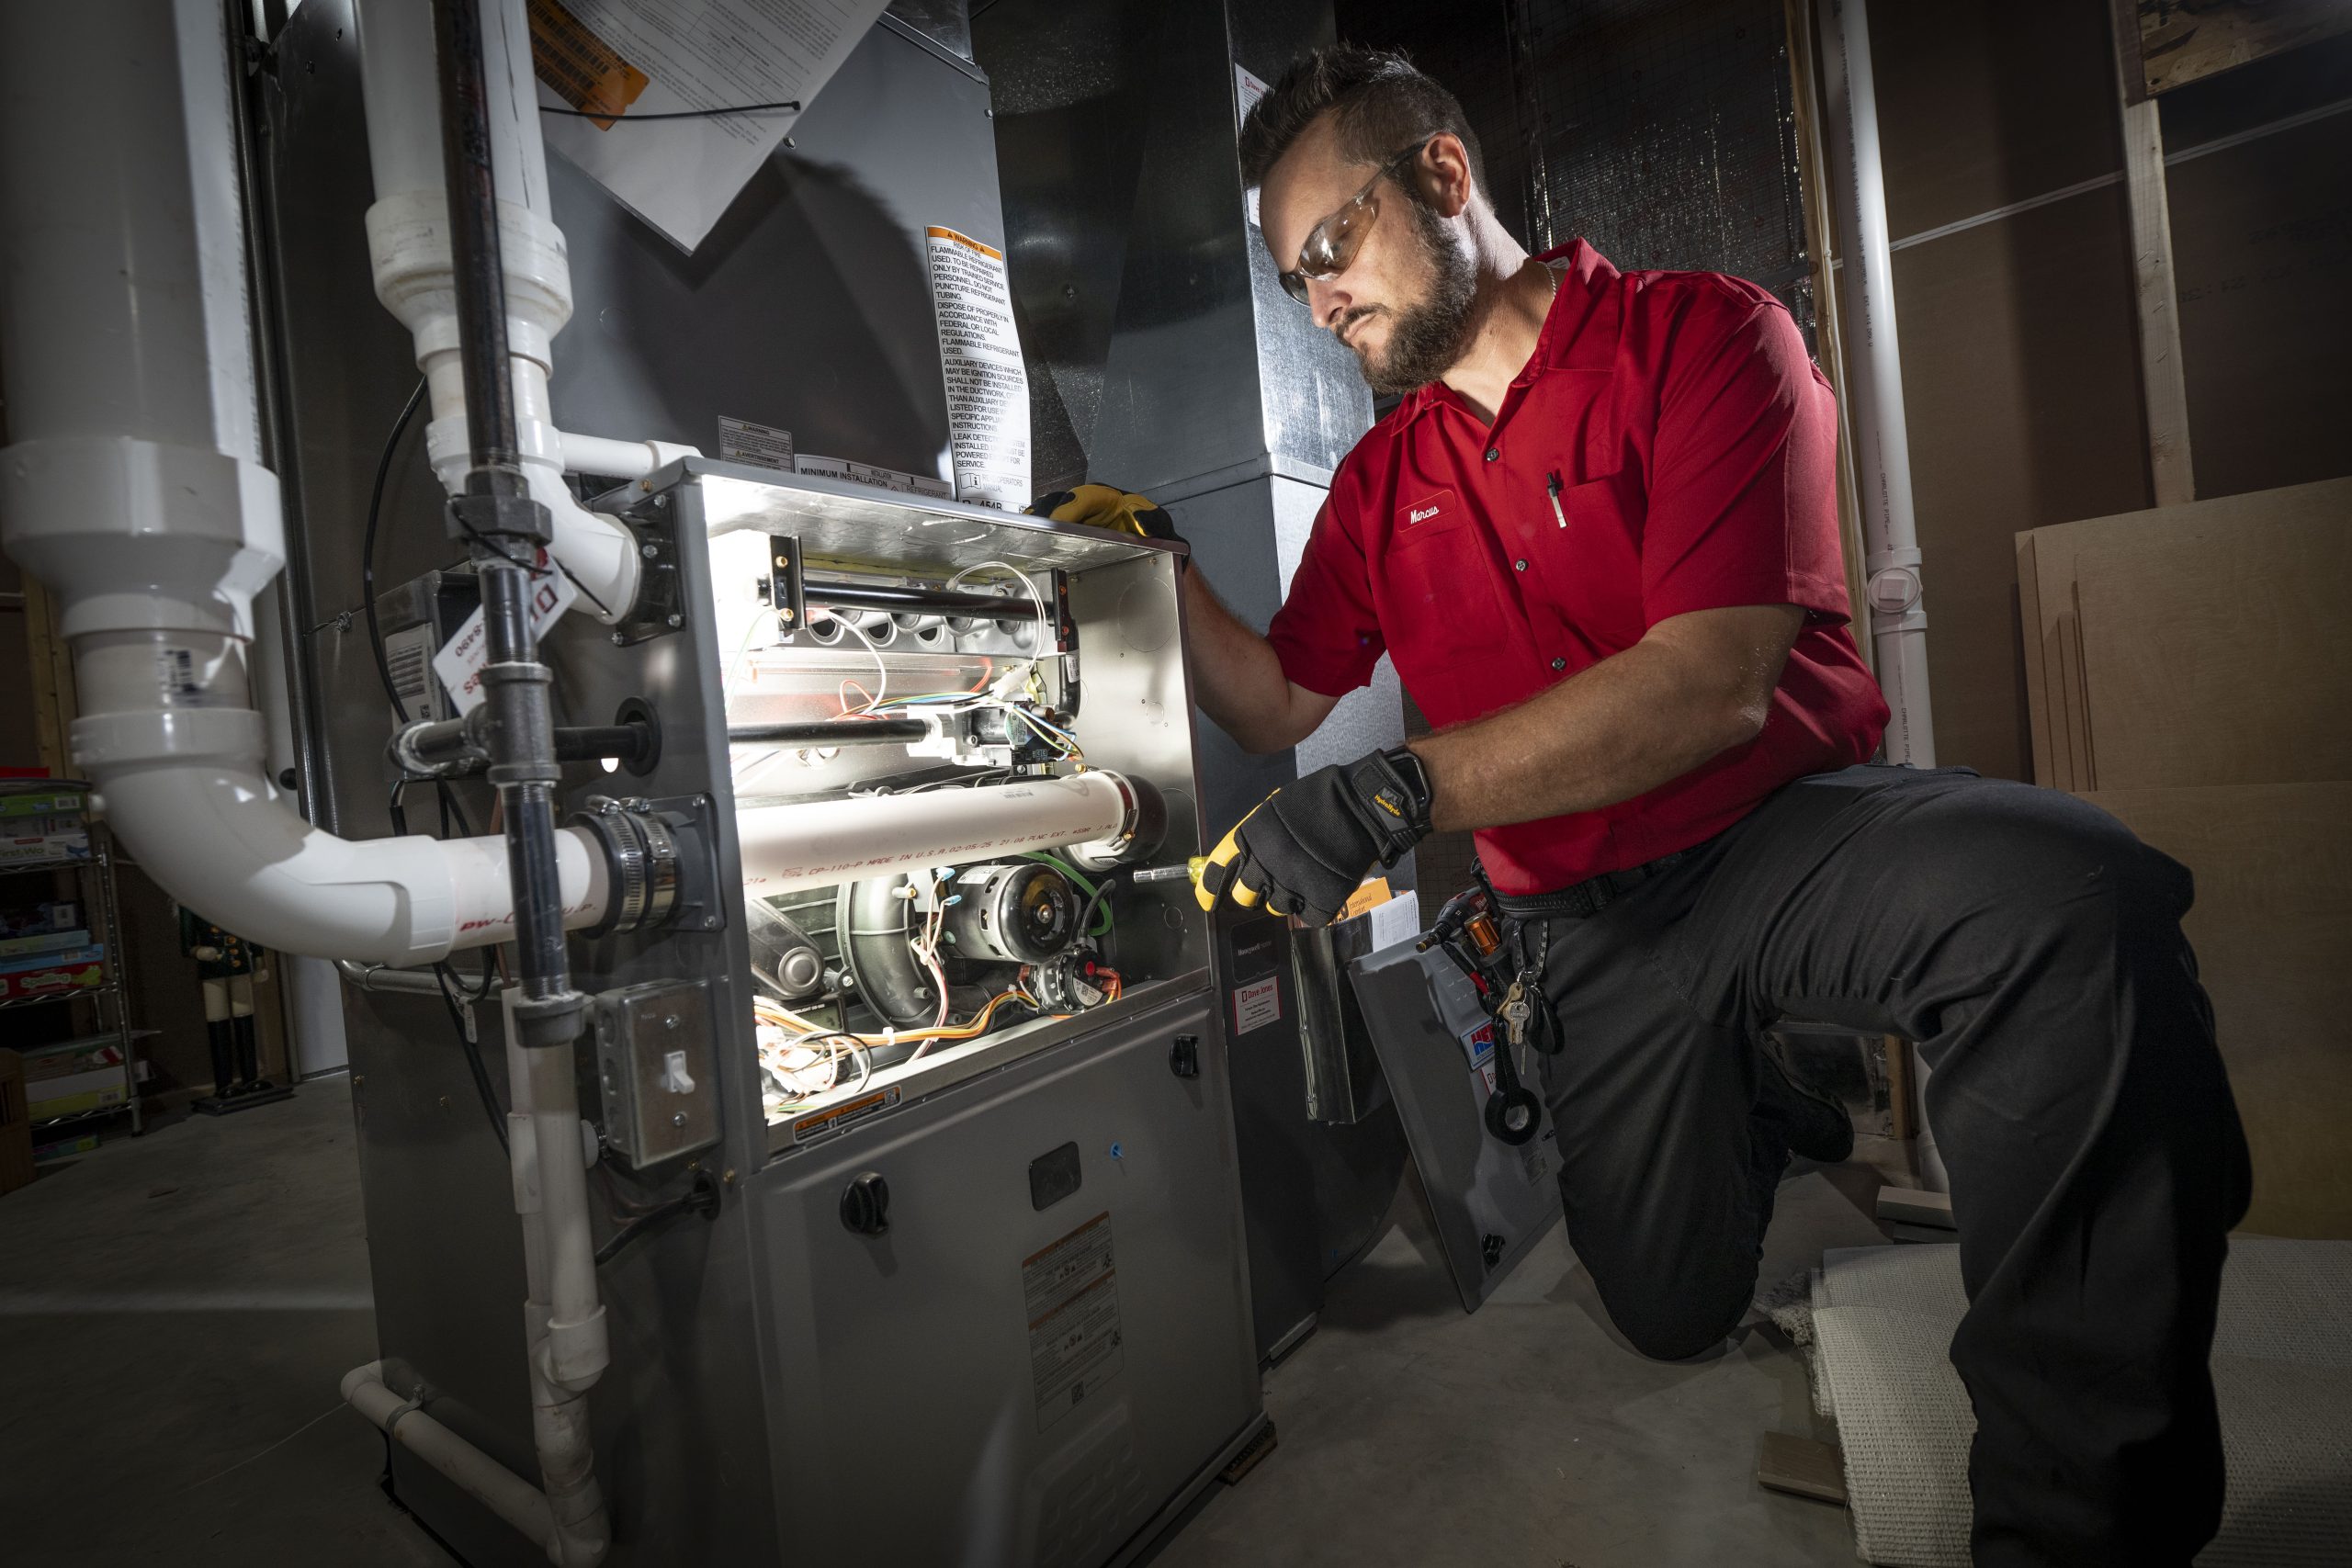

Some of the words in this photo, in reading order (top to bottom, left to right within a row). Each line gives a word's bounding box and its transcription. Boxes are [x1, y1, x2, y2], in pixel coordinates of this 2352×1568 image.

[954, 234, 978, 250] WARNING
[931, 246, 967, 259] FLAMMABLE
[968, 255, 1002, 273] REFRIGERANT
[962, 260, 968, 268] BE
[969, 263, 994, 278] REPAIRED
[961, 268, 983, 282] TRAINED
[984, 276, 1005, 290] SERVICE
[974, 280, 982, 288] DO
[983, 283, 992, 293] NOT
[935, 283, 970, 294] PUNCTURE
[971, 289, 1005, 306] REFRIGERANT
[936, 292, 963, 300] TUBING.
[938, 302, 966, 310] DISPOSE
[977, 307, 1002, 321] PROPERLY
[939, 311, 983, 323] ACCORDANCE
[984, 319, 998, 327] WITH
[940, 321, 970, 330] FEDERAL
[980, 325, 999, 335] LOCAL
[941, 330, 986, 341] REGULATIONS.
[943, 338, 982, 348] FLAMMABLE
[983, 344, 1019, 357] REFRIGERANT
[944, 359, 978, 368] AUXILIARY
[978, 363, 1003, 372] DEVICES
[1004, 367, 1022, 376] WHICH
[971, 369, 996, 379] IGNITION
[997, 374, 1023, 384] SOURCES
[992, 381, 1022, 392] INSTALLED
[968, 396, 999, 406] AUXILIARY
[748, 426, 770, 435] WARNING
[800, 468, 838, 479] MINIMUM
[840, 471, 888, 488] INSTALLATION
[907, 486, 947, 499] REFRIGERANT
[1880, 472, 1888, 506] CHARLOTTE
[1410, 506, 1440, 525] Marcus
[1882, 509, 1890, 525] PIPE
[808, 861, 863, 875] CP-110-P
[866, 856, 894, 866] MADE
[899, 853, 912, 862] IN
[1238, 942, 1260, 956] Honeywell
[21, 974, 71, 988] Spelling
[1248, 989, 1260, 998] Dave
[1261, 985, 1273, 994] Jones
